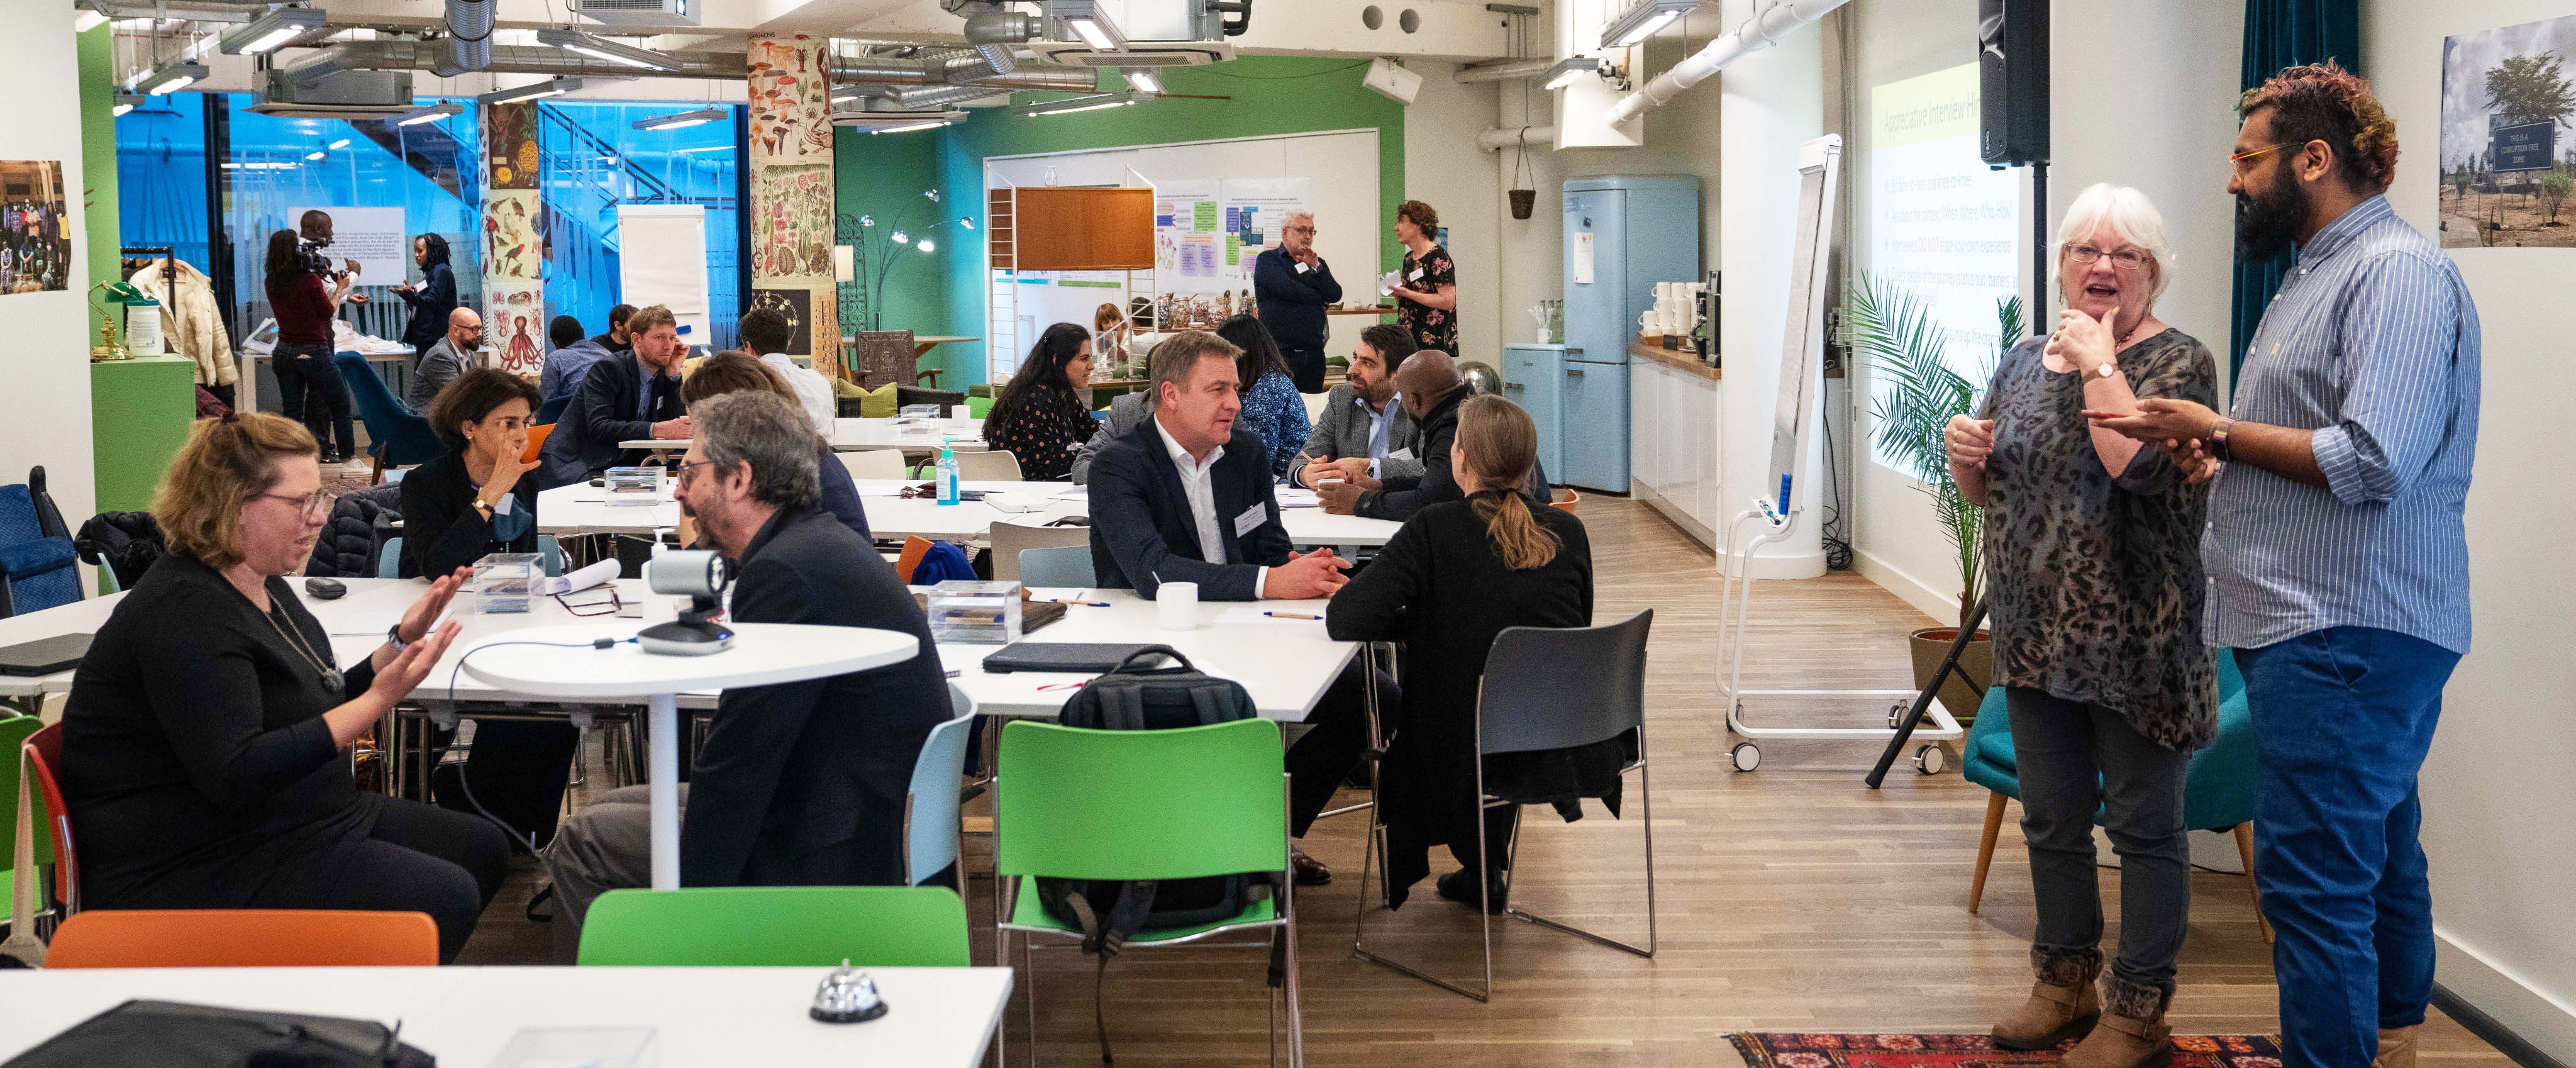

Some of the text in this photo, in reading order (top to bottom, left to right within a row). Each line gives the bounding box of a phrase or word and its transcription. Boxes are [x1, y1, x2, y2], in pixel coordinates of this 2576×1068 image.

[1884, 91, 1980, 139] Appreciative Interview Hin
[2501, 144, 2527, 154] CORRUPTION
[1927, 176, 1936, 191] and
[1997, 201, 2012, 221] How)
[1918, 236, 1927, 252] DO
[1928, 236, 1939, 252] NOT
[1940, 238, 1953, 252] share
[1954, 241, 1966, 257] your
[1967, 241, 1978, 252] own
[1980, 238, 2011, 257] experience
[1937, 271, 1955, 289] journey
[1956, 269, 1974, 289] (status
[1989, 270, 2010, 289] barriers,
[1964, 332, 1970, 347] up
[1972, 327, 1980, 344] the
